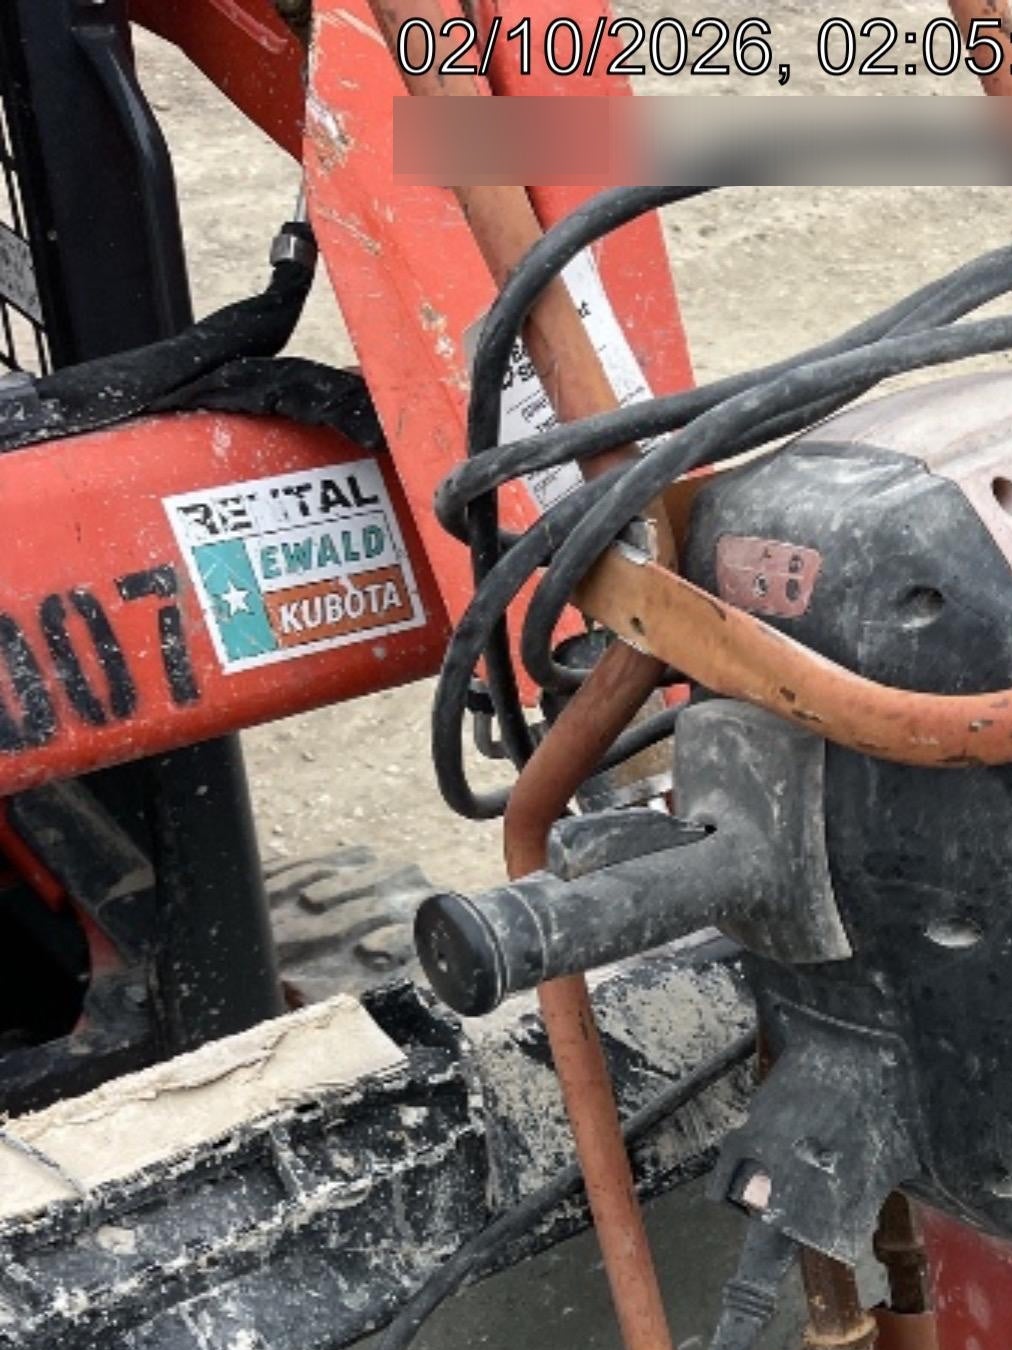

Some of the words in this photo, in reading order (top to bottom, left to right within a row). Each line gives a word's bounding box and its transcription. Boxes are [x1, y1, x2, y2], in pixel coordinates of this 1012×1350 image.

[176, 476, 379, 535] RETAL
[259, 524, 385, 580] EWALD
[279, 581, 403, 635] KUBOTA
